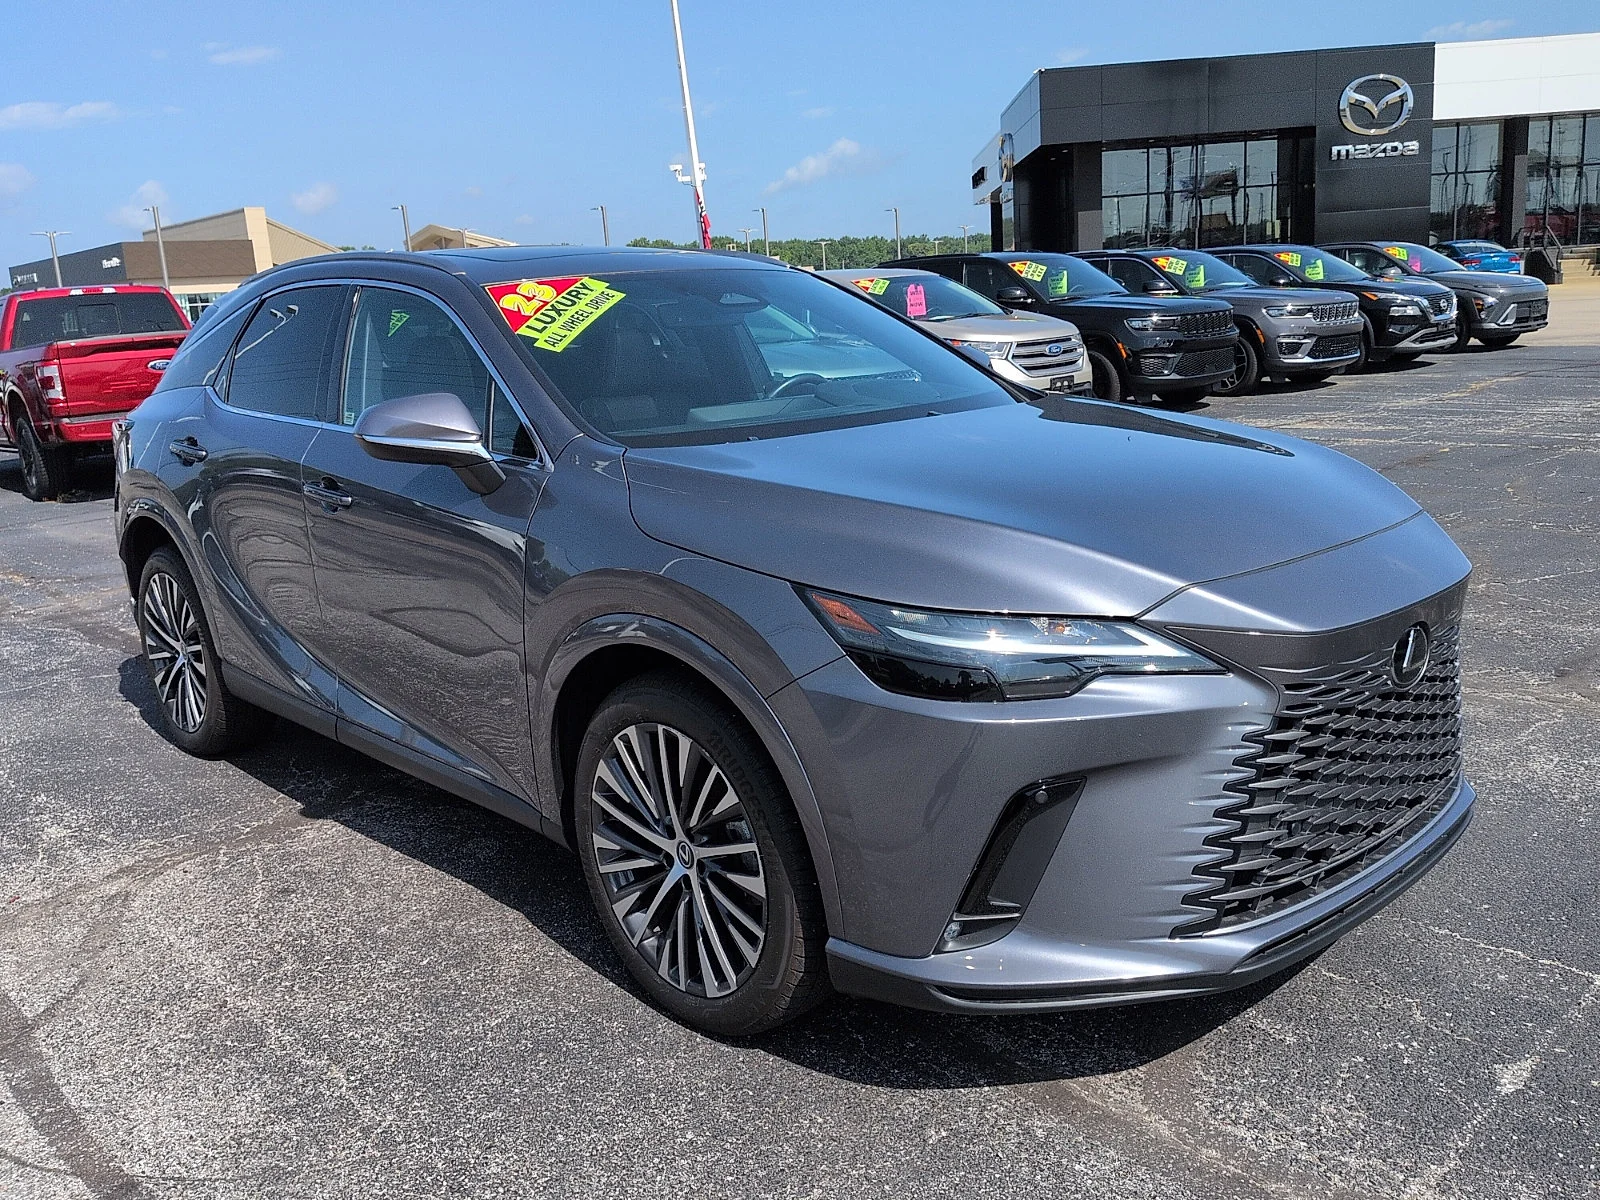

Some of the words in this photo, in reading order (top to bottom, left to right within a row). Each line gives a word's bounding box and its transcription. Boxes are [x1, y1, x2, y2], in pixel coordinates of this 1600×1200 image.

[1331, 140, 1420, 160] mazda
[499, 281, 557, 316] 23
[525, 282, 594, 334] LUXURY
[543, 331, 567, 348] ALL
[558, 308, 594, 332] WHEEL
[589, 290, 616, 310] DRIVE
